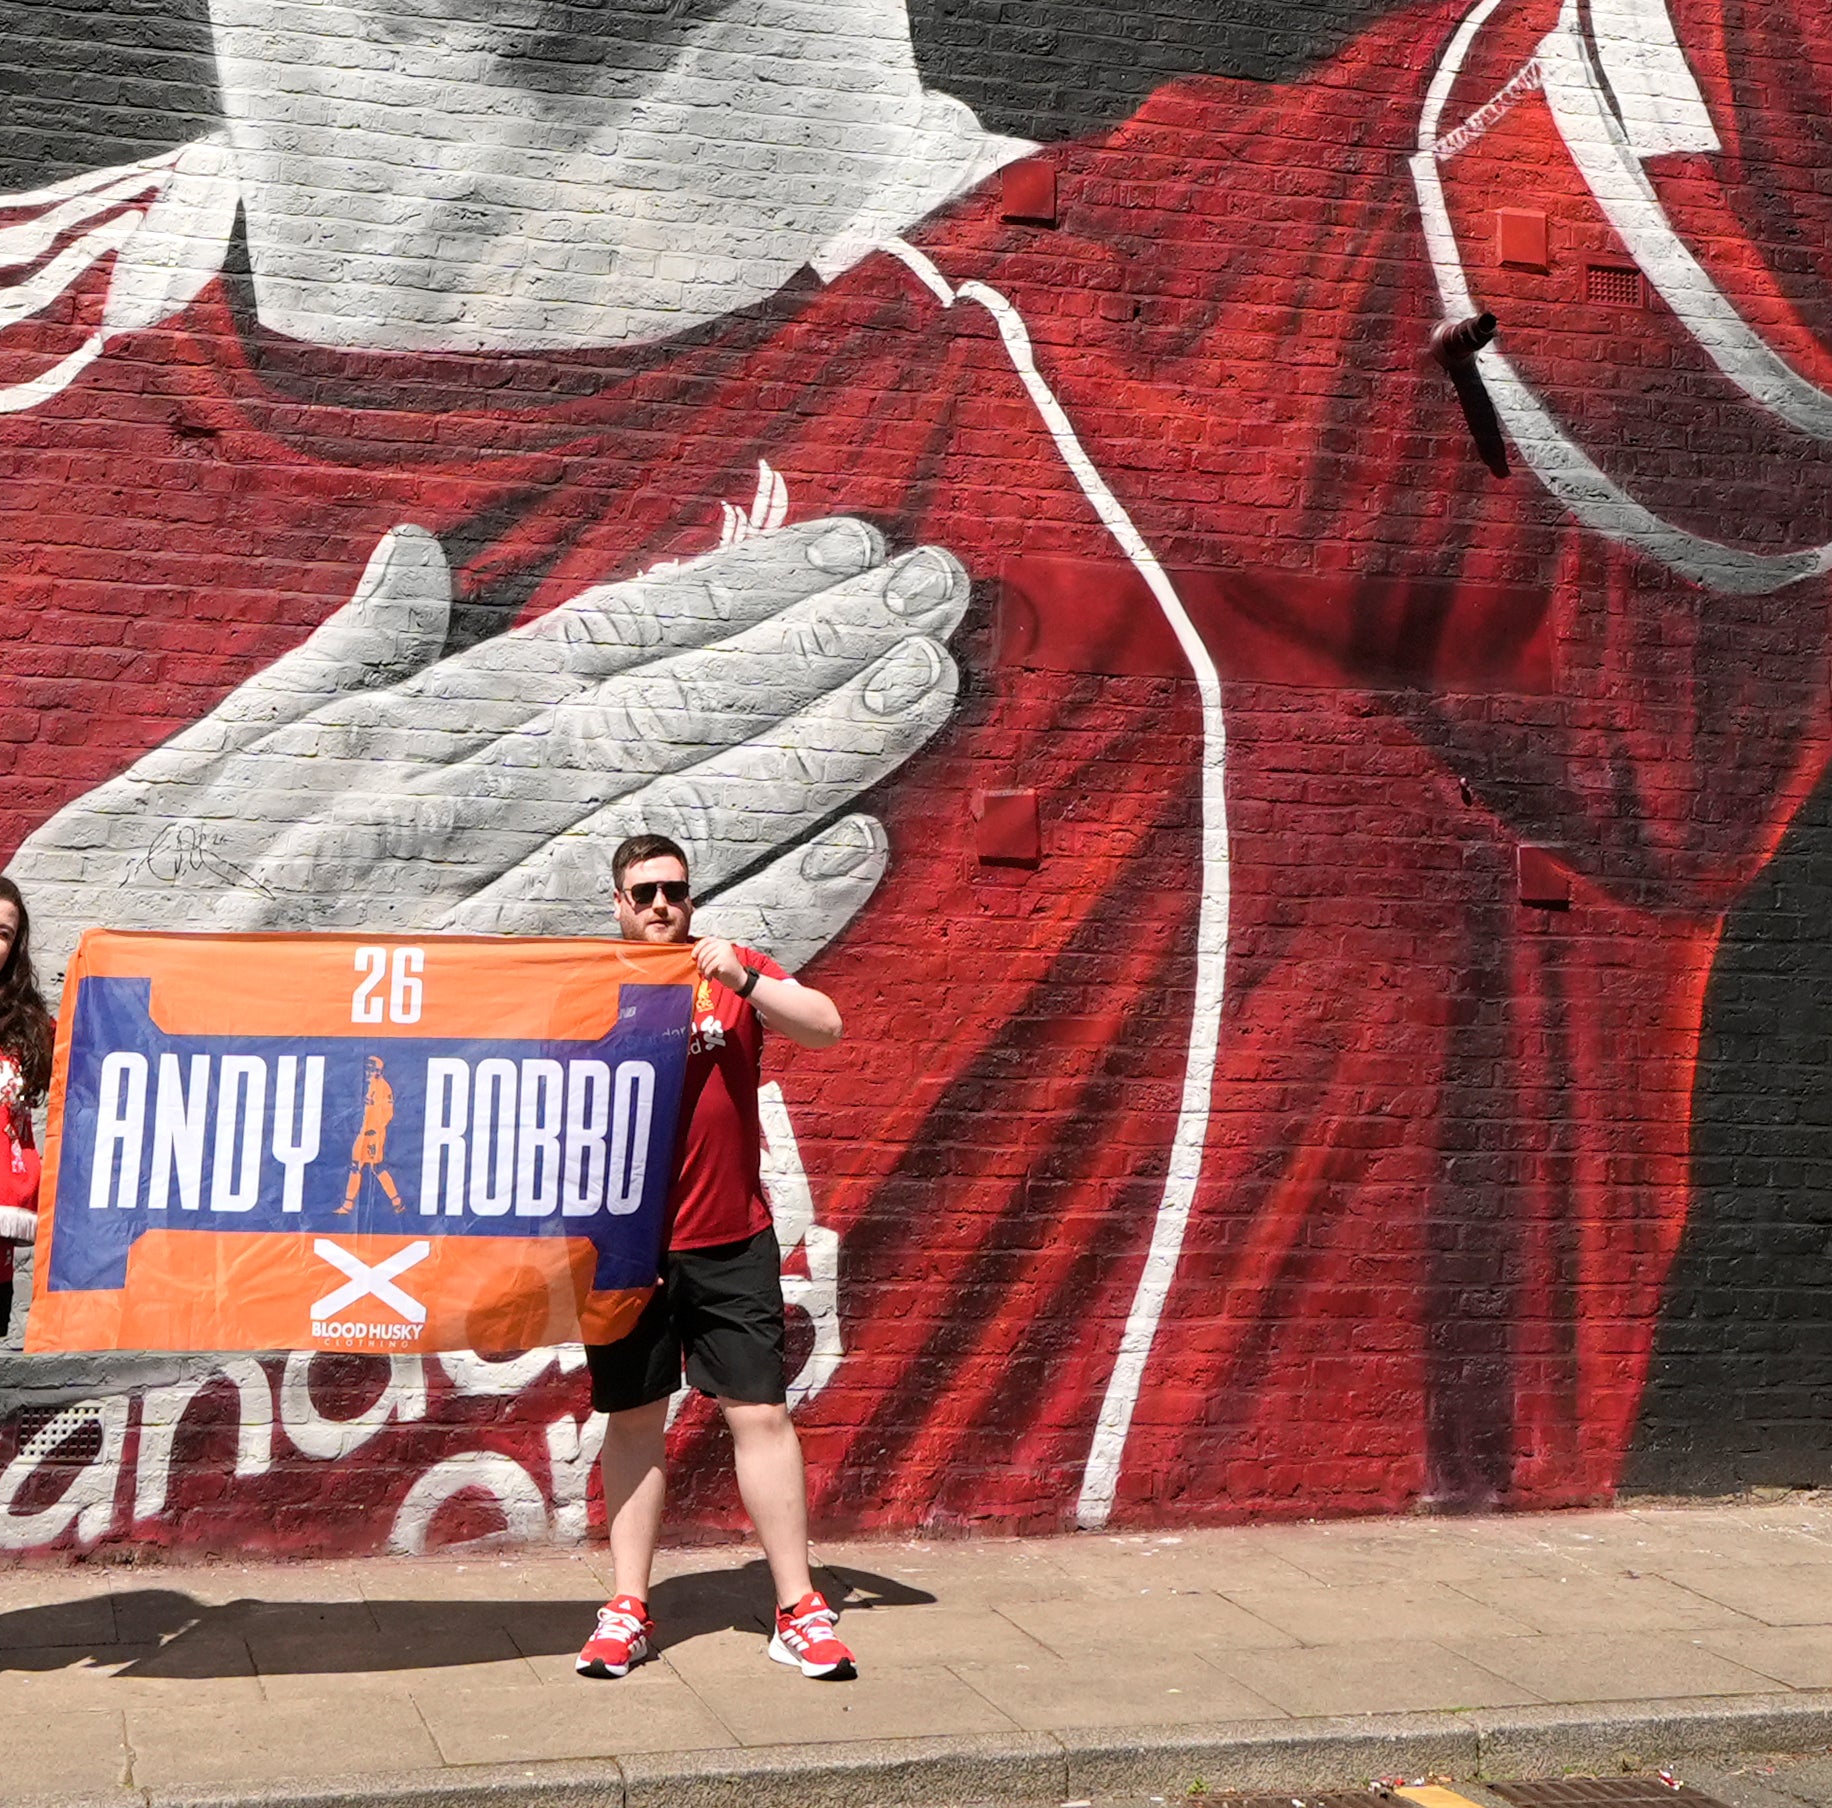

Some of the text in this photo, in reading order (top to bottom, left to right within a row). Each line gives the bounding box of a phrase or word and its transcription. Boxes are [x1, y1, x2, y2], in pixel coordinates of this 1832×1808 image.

[352, 946, 424, 1025] 26
[88, 1051, 656, 1218] ANDY ROBBO
[311, 1321, 424, 1341] BLOOD HUSKY
[324, 1337, 409, 1348] CLOTHING
